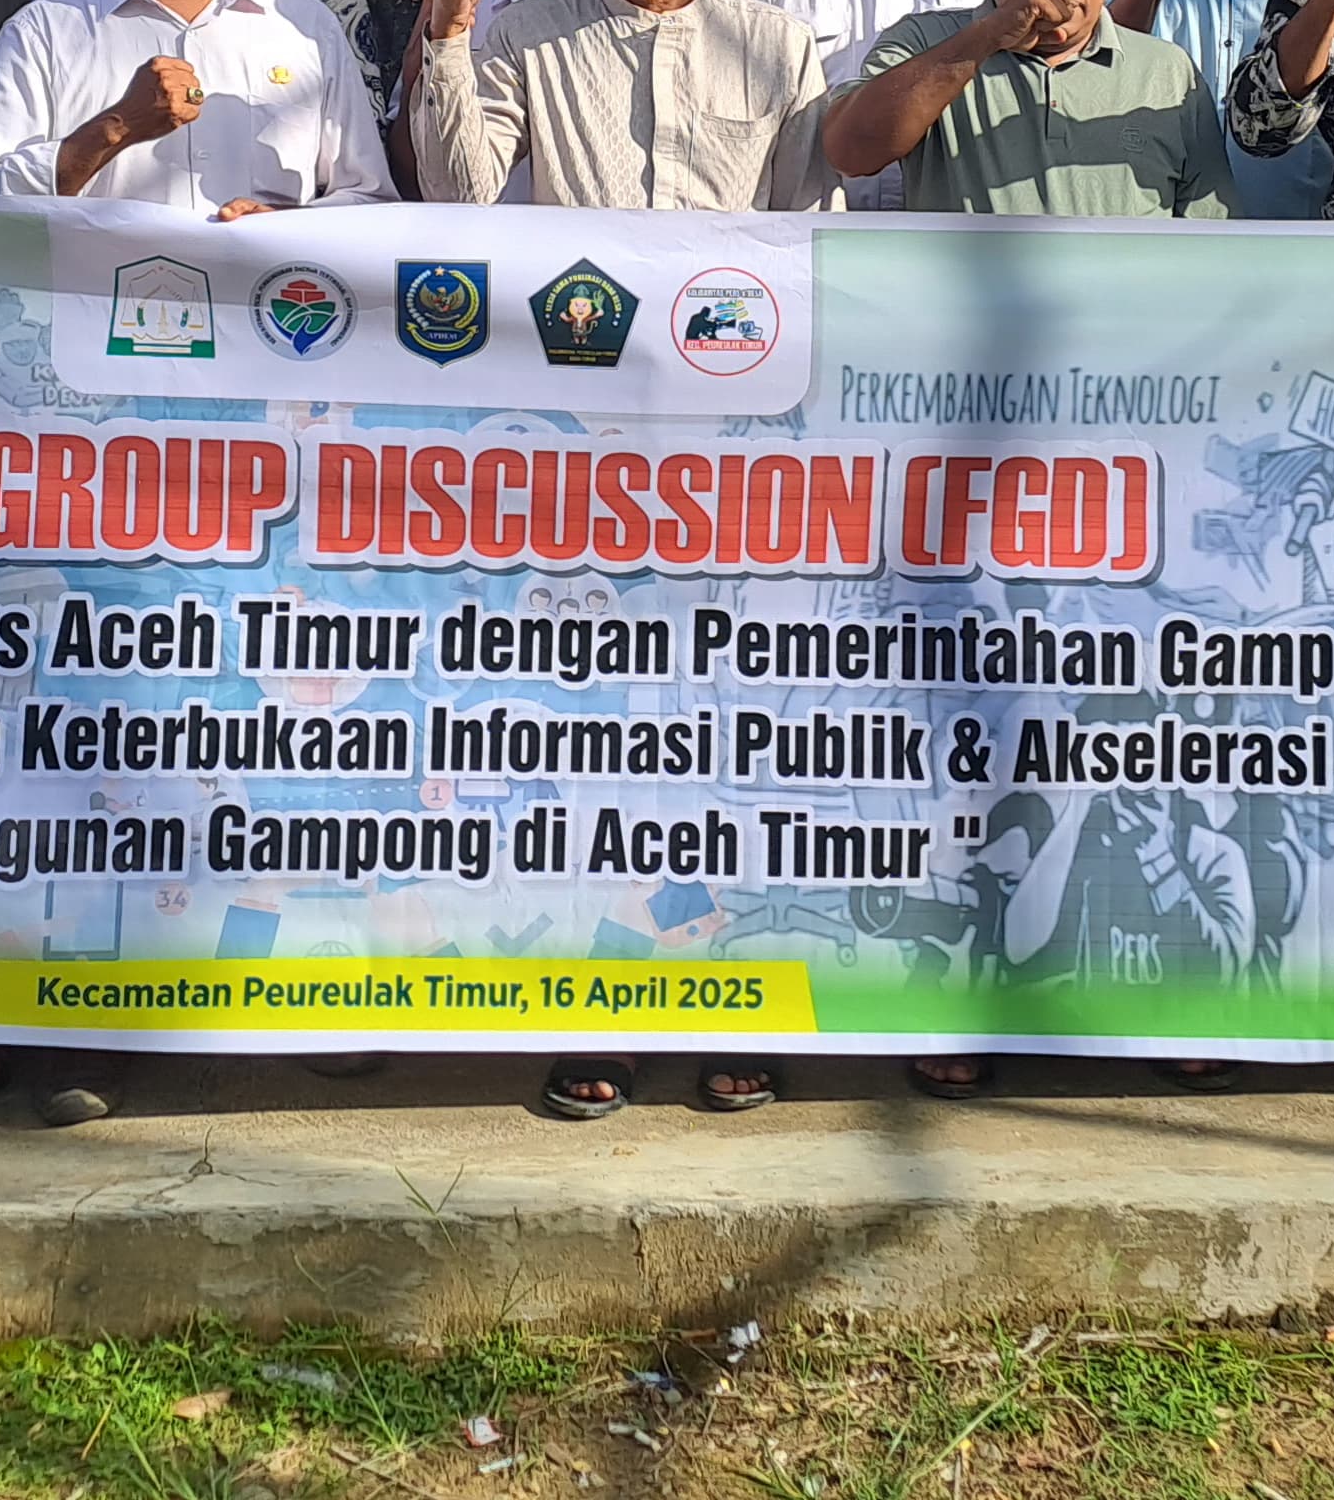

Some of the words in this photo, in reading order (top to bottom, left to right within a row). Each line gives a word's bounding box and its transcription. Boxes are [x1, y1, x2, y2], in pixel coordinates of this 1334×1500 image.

[315, 440, 873, 565] DISCUSSION
[901, 455, 1150, 570] (FGD)
[51, 599, 216, 670] Aceh
[238, 600, 421, 673] Timur
[440, 604, 669, 685] dengan
[691, 609, 1137, 687] Pemerintahan
[20, 701, 408, 774] Keterbukaan
[431, 705, 713, 777] Informasi
[734, 710, 924, 782] Publik
[947, 719, 991, 784] &
[1012, 717, 1329, 788] Akselerasi
[206, 803, 490, 881] Gampong
[514, 808, 567, 874] di
[587, 807, 739, 879] Aceh
[760, 811, 931, 879] Timur
[36, 976, 232, 1009] Kecamatan
[241, 974, 414, 1009] Peureulak
[425, 975, 530, 1013] Timur,
[539, 977, 575, 1009] 16
[583, 975, 668, 1017] April
[677, 977, 764, 1009] 2025
[1110, 925, 1163, 984] PERS
